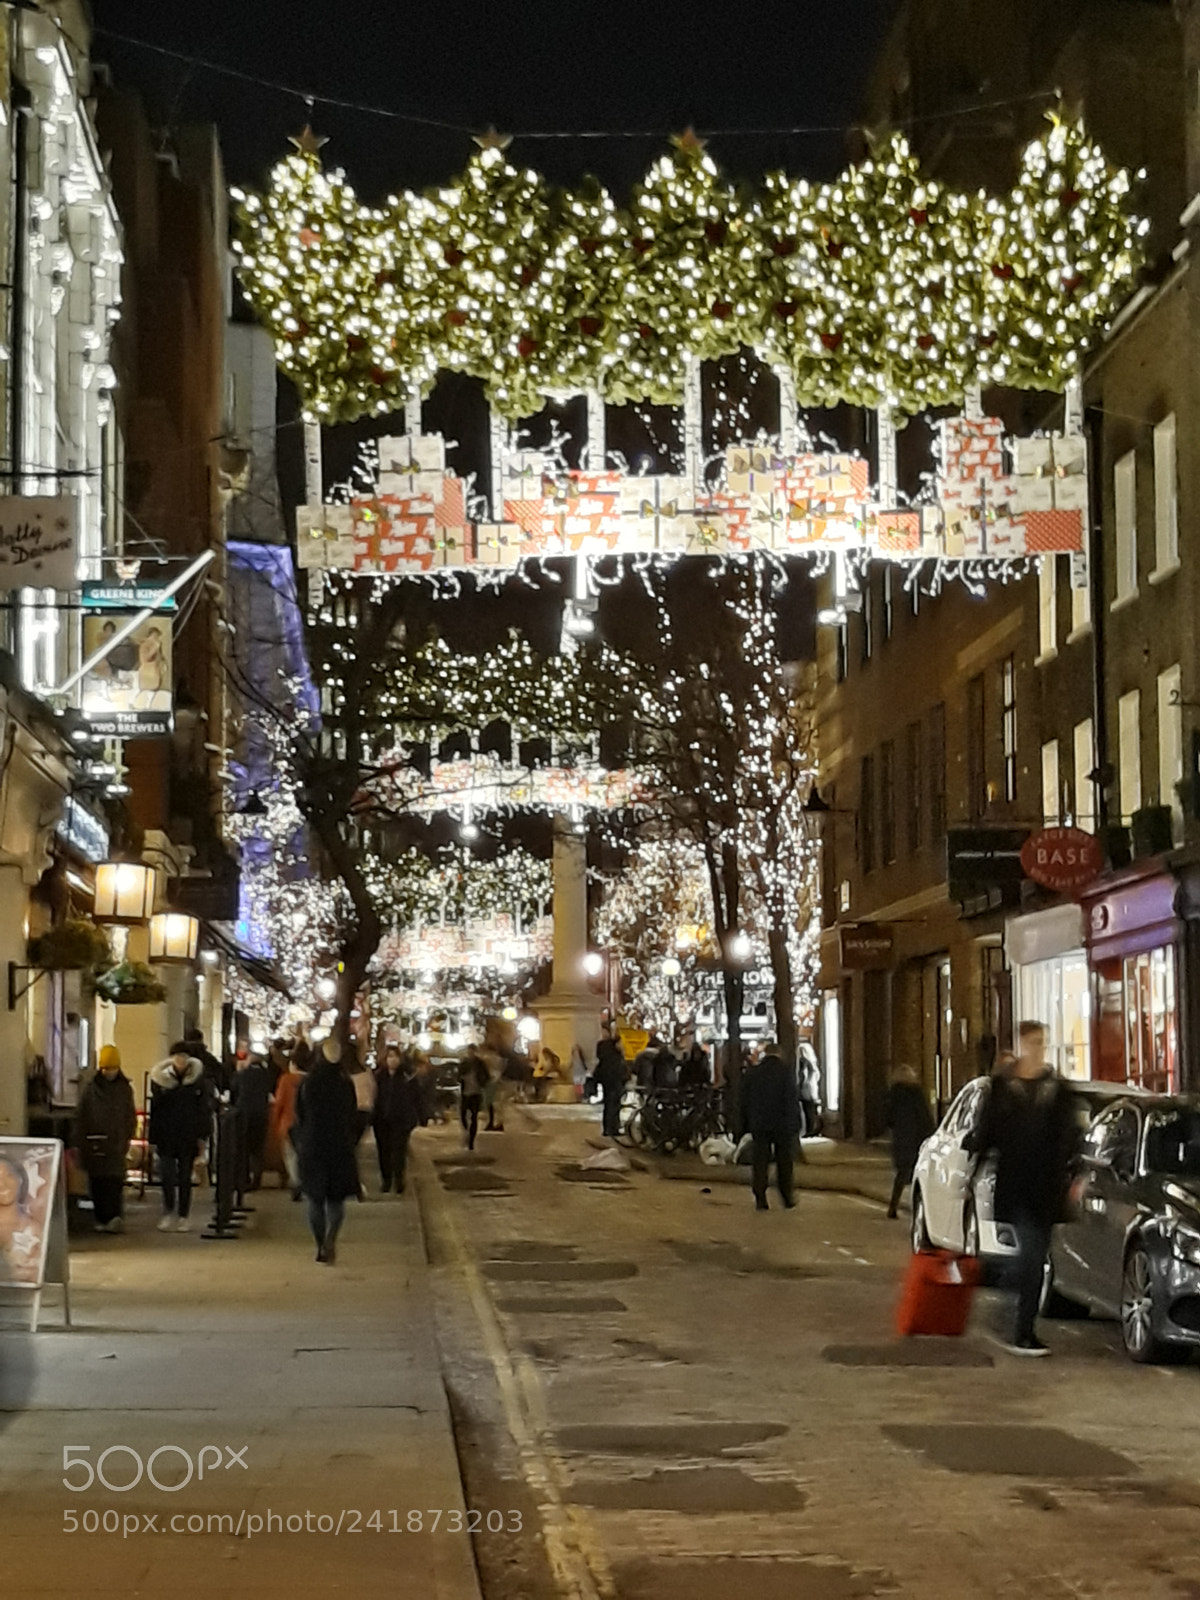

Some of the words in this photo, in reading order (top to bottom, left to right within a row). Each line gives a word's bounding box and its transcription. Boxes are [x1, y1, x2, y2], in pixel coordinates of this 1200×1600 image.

[90, 588, 134, 599] GREENE
[116, 713, 138, 722] THE
[90, 723, 116, 732] TWO
[117, 723, 165, 733] BREWERS
[1037, 848, 1090, 865] BASE
[695, 971, 725, 987] THE
